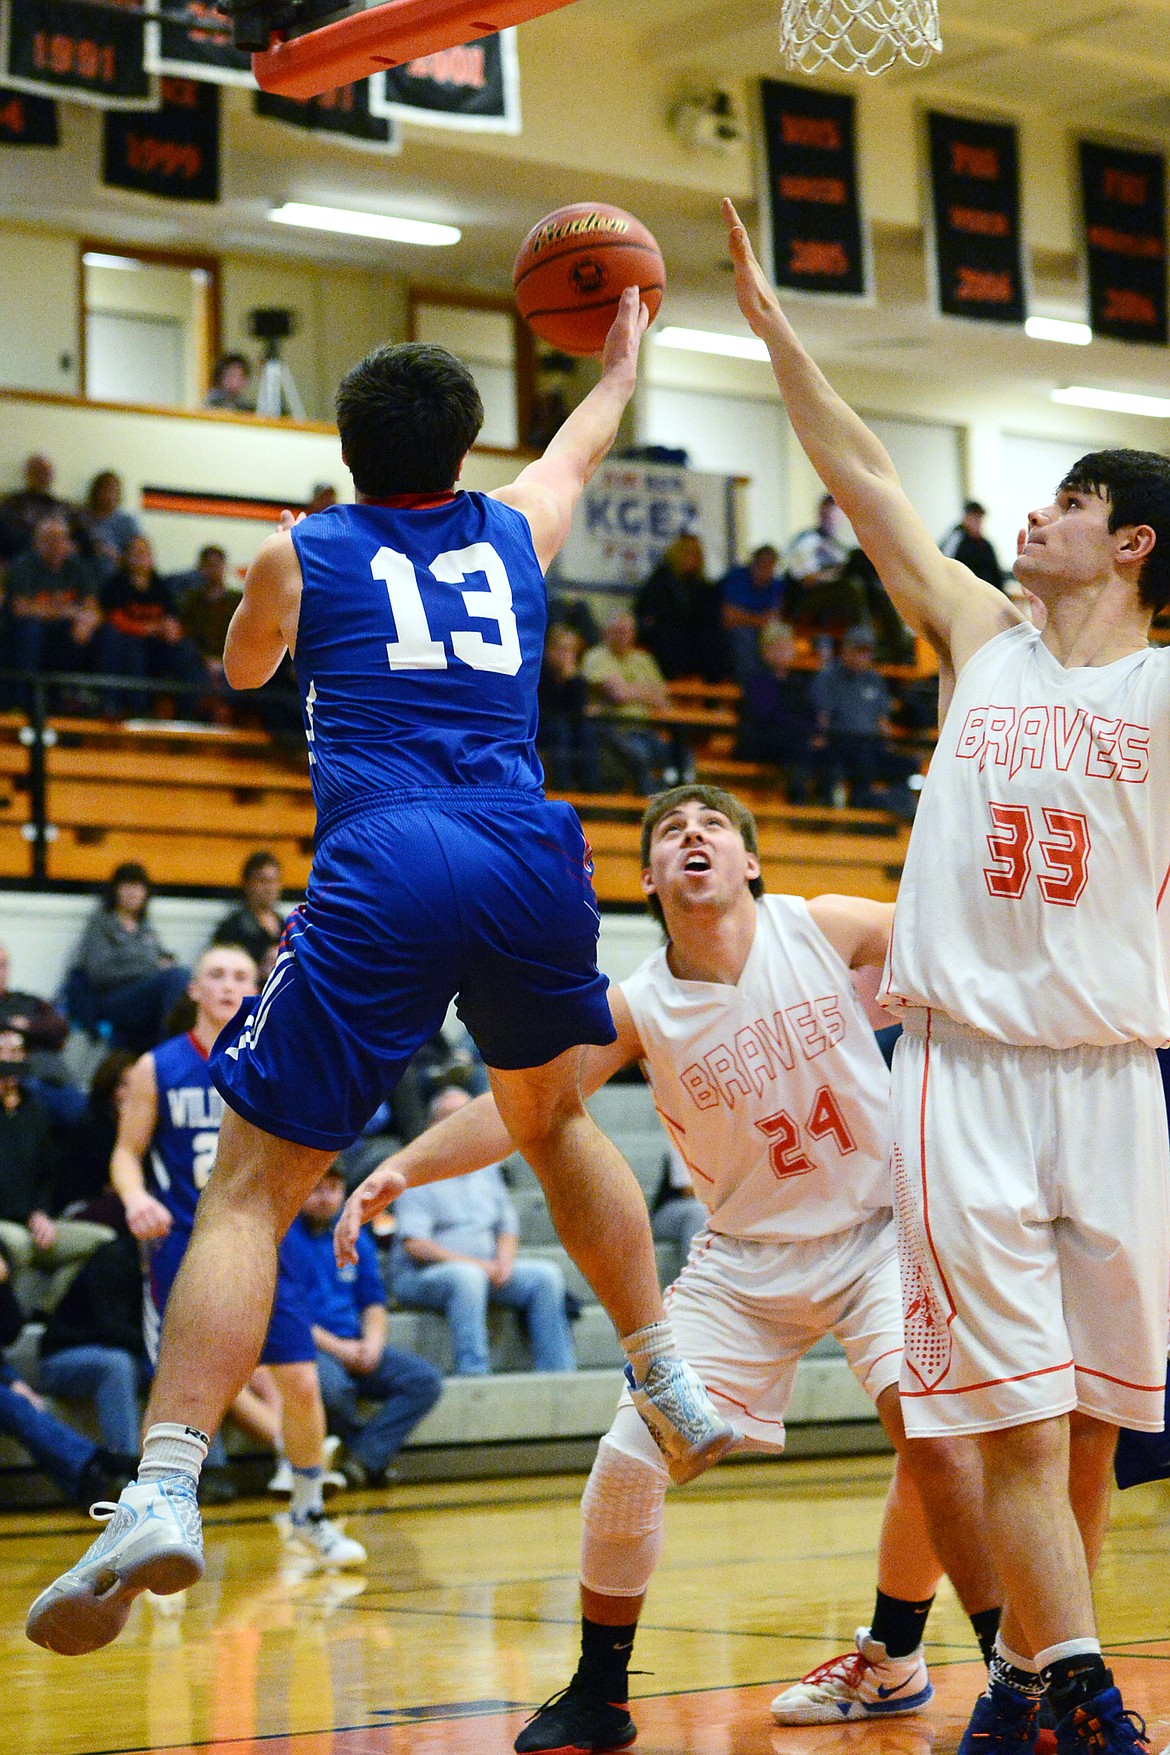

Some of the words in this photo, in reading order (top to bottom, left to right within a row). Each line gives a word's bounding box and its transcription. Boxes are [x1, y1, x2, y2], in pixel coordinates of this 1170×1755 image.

[370, 542, 522, 676] 13
[956, 704, 1150, 783] BRAVES
[983, 801, 1092, 907] 33
[681, 995, 847, 1112] BRAVES
[756, 1085, 858, 1180] 24
